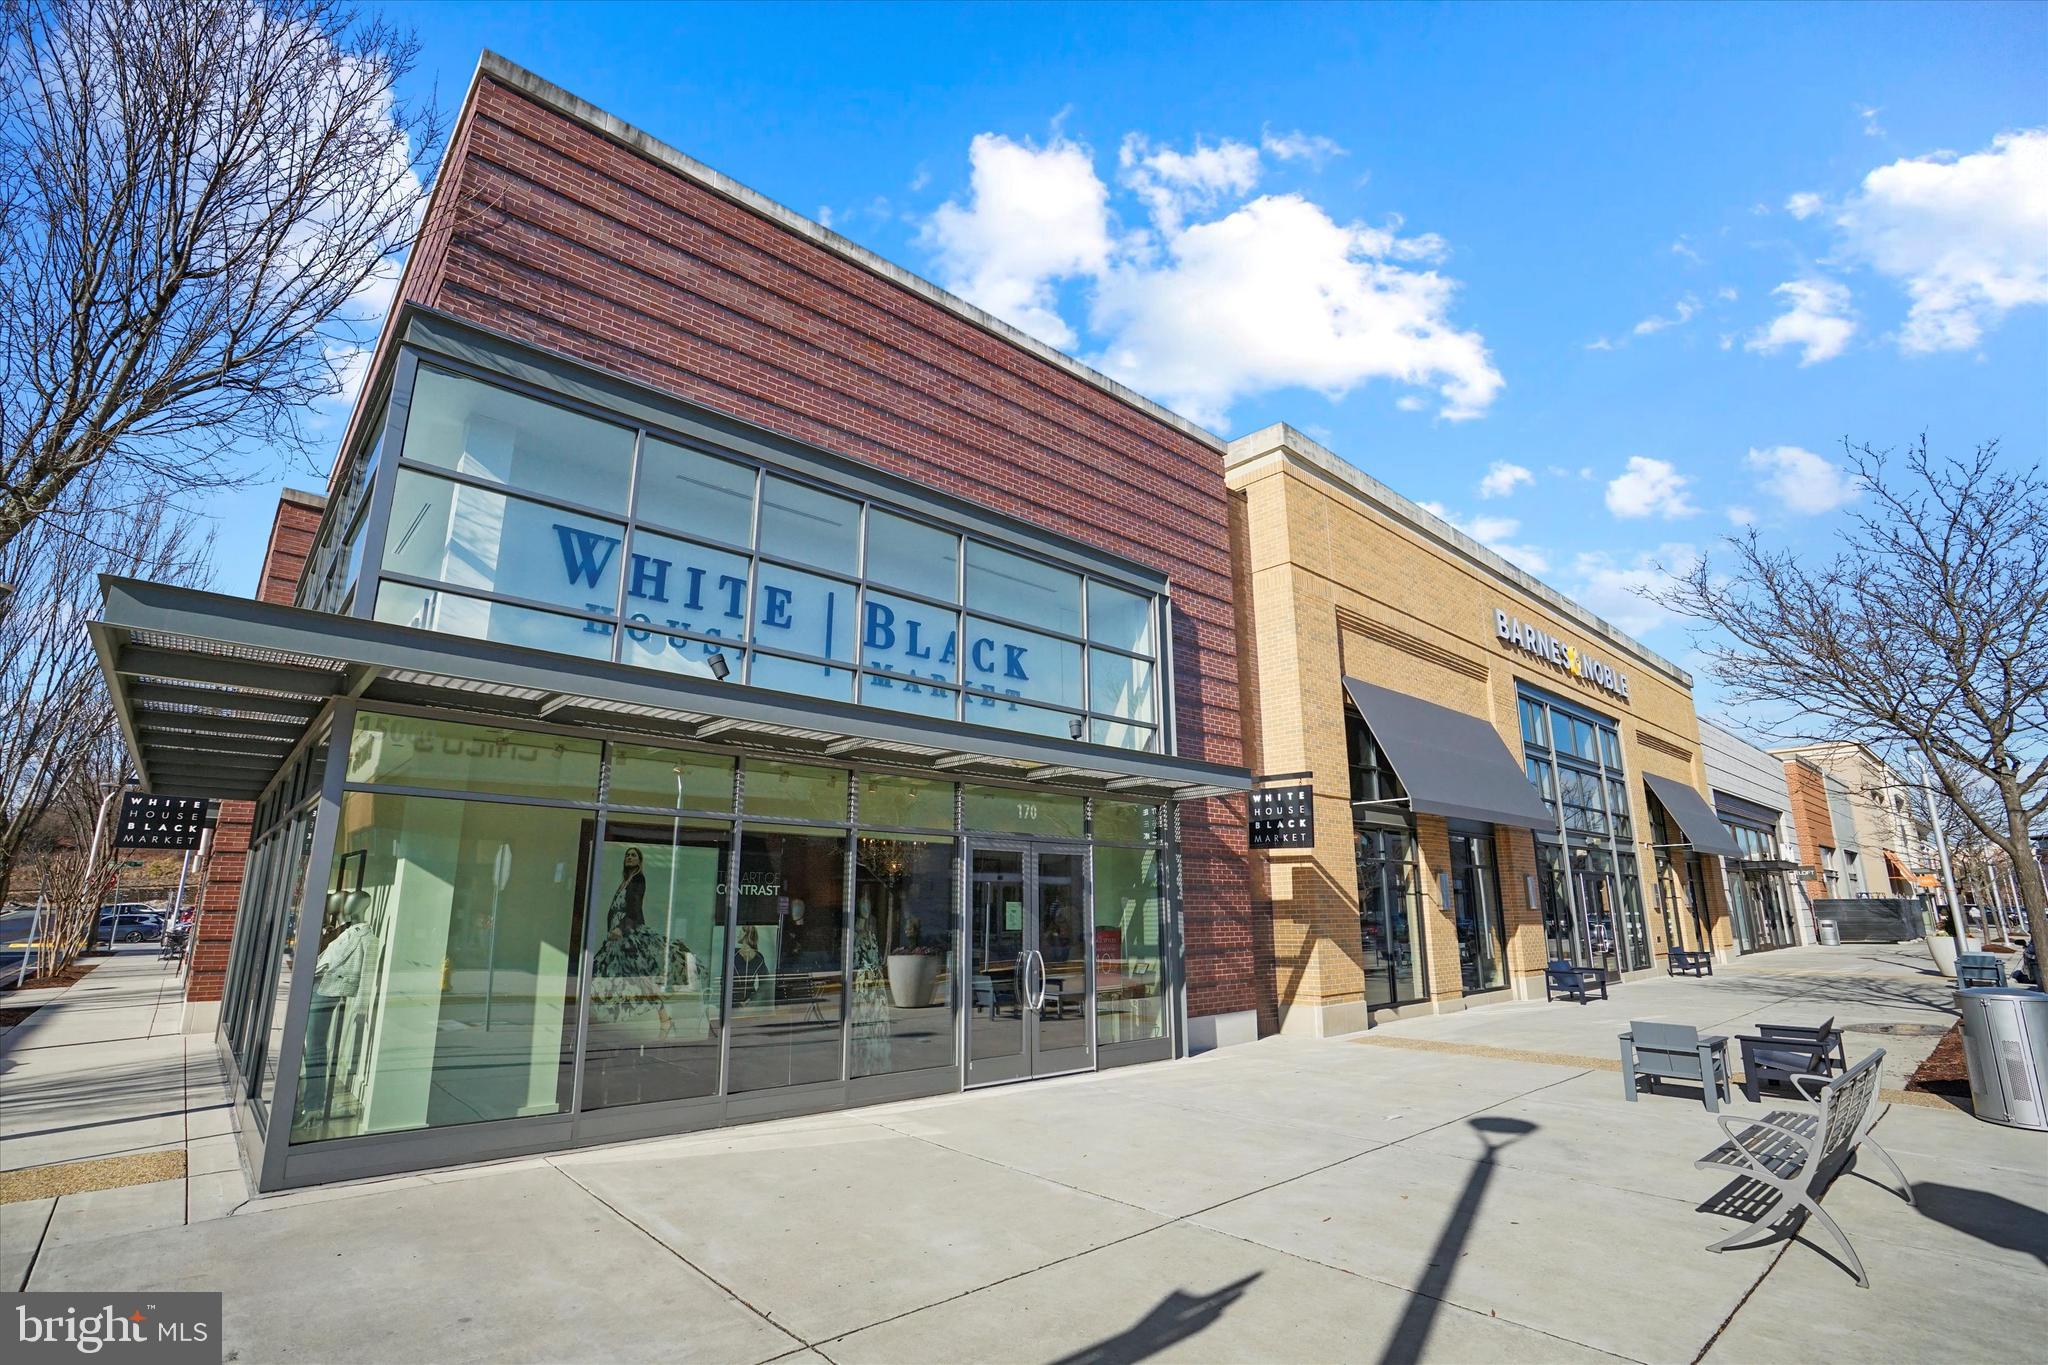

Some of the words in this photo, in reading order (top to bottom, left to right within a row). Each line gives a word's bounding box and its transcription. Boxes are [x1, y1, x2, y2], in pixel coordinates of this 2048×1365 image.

[552, 523, 793, 629] WHITE
[864, 601, 1029, 680] BLACK
[1494, 608, 1571, 669] BARNES
[1567, 646, 1581, 676] &
[1580, 654, 1629, 698] NOBLE
[131, 797, 200, 808] WHITE
[1252, 791, 1305, 803] WHITE
[129, 810, 198, 821] HOUSE
[1016, 803, 1037, 820] 170
[1254, 805, 1305, 816] HOUSE
[127, 822, 197, 833] BLACK
[1255, 818, 1306, 830] BLACK
[123, 834, 194, 845] MARKET
[1254, 833, 1306, 843] MARKET
[716, 883, 781, 896] CNTRAST
